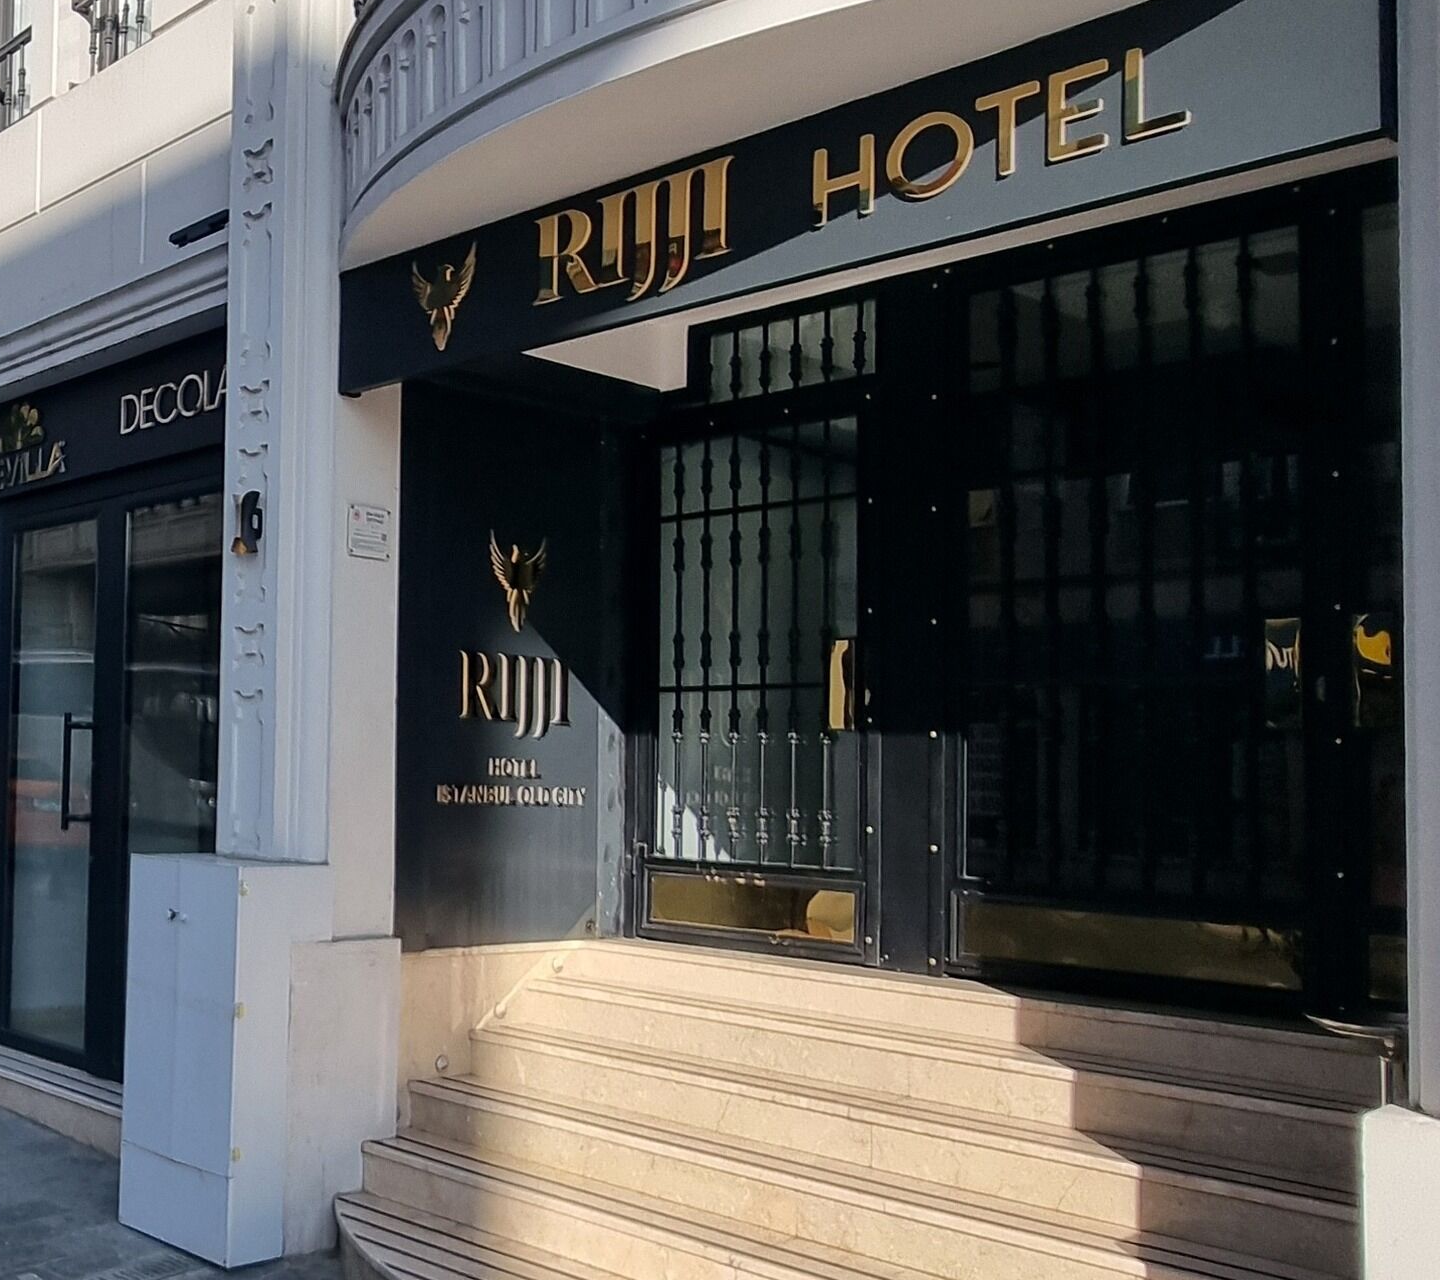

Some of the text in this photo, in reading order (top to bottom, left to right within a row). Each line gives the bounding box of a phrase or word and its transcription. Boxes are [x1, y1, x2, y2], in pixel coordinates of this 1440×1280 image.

[533, 48, 1192, 306] RIJJI HOTEL
[488, 757, 541, 779] HOTEL
